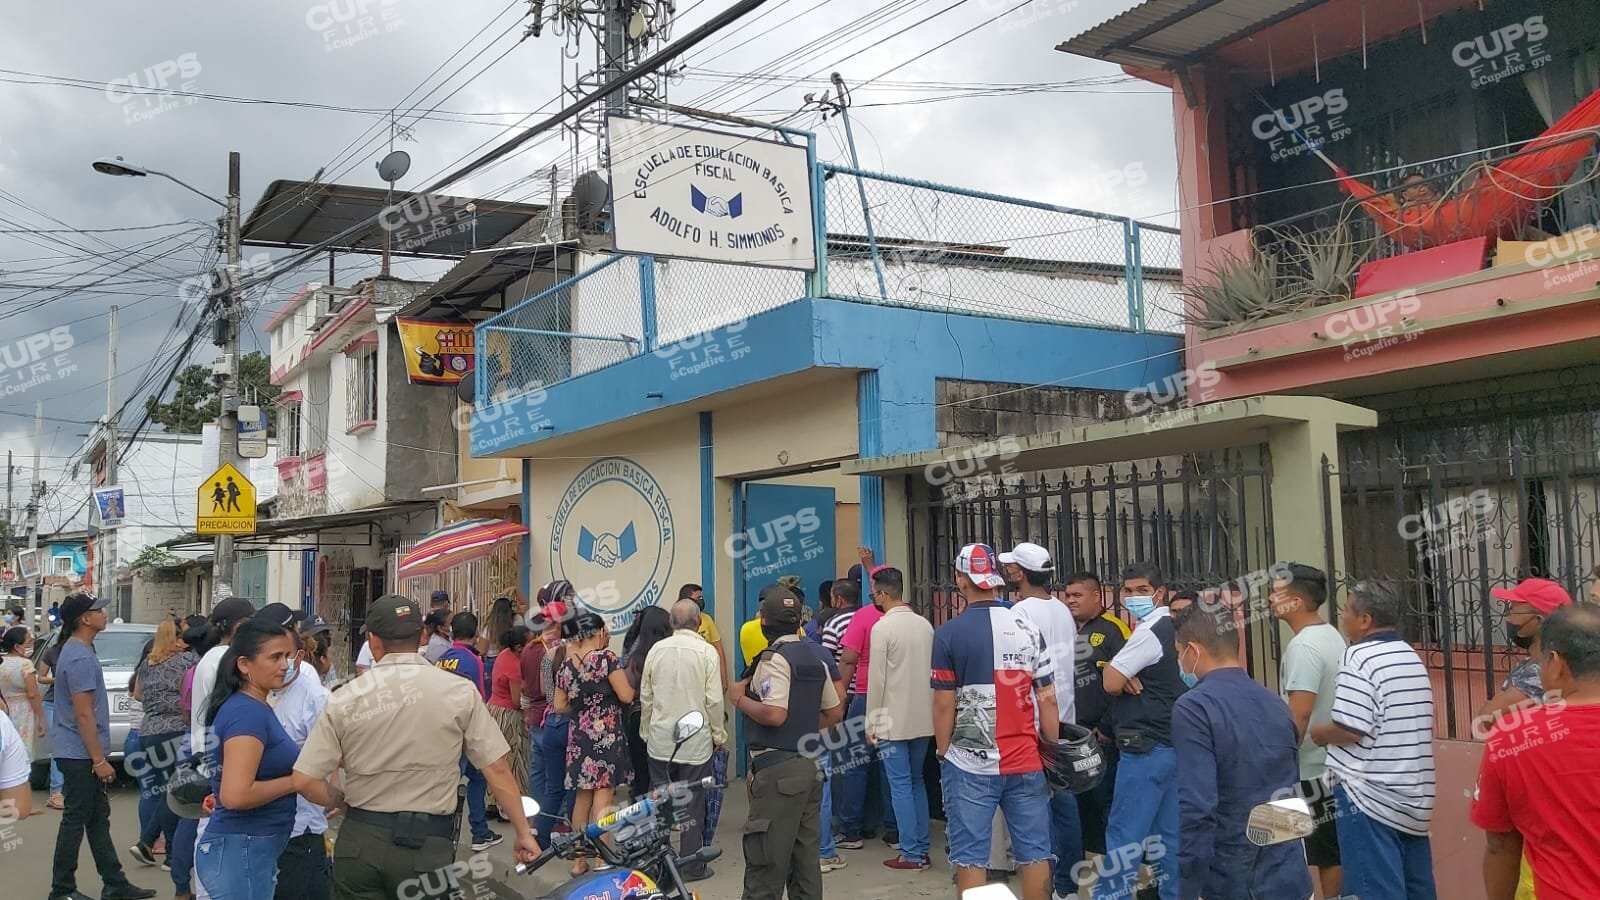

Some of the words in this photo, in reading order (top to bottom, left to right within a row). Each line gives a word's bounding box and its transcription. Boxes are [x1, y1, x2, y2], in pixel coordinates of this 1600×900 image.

[634, 150, 677, 199] ESCUELA
[677, 145, 693, 159] DE
[695, 144, 762, 174] EDUCACION
[762, 167, 794, 215] BASICA
[695, 163, 736, 181] FISCAL
[650, 206, 701, 243] ADOLFO
[709, 231, 722, 248] H.
[727, 223, 785, 249] SIMMONDS
[200, 521, 253, 529] PRECAUCION
[552, 501, 570, 552] ESCUELA
[568, 487, 577, 502] DE
[577, 462, 621, 492] EDUCACION
[623, 464, 654, 500] BASICA
[654, 495, 672, 545] FISCAL
